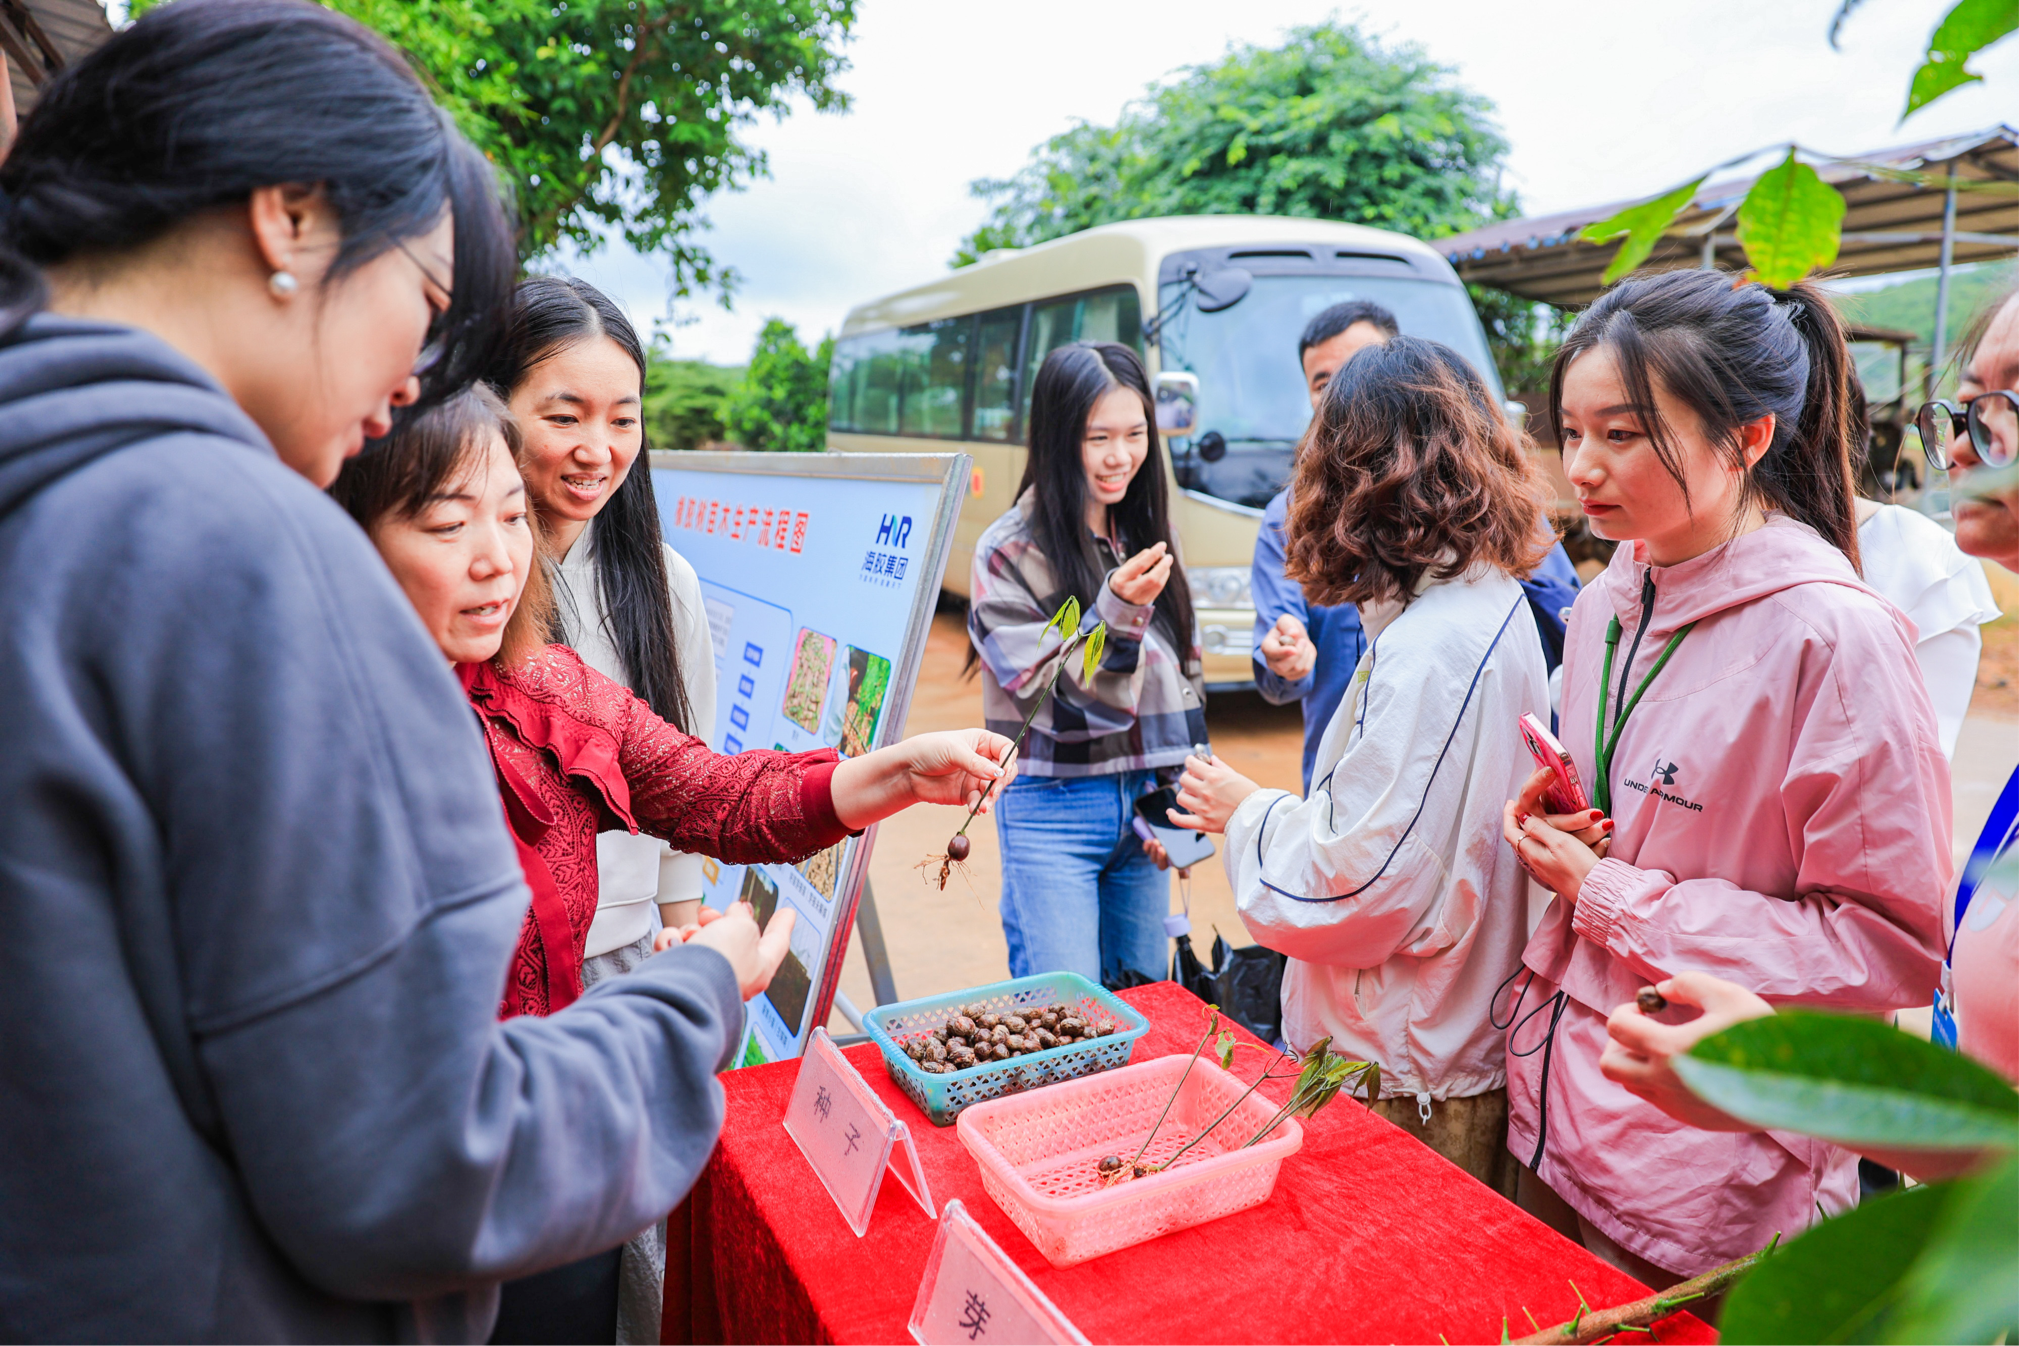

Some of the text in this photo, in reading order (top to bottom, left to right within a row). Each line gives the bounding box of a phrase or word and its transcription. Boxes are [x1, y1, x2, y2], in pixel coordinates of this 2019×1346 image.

[861, 551, 908, 580] 海胶集团
[814, 1085, 860, 1156] 种子
